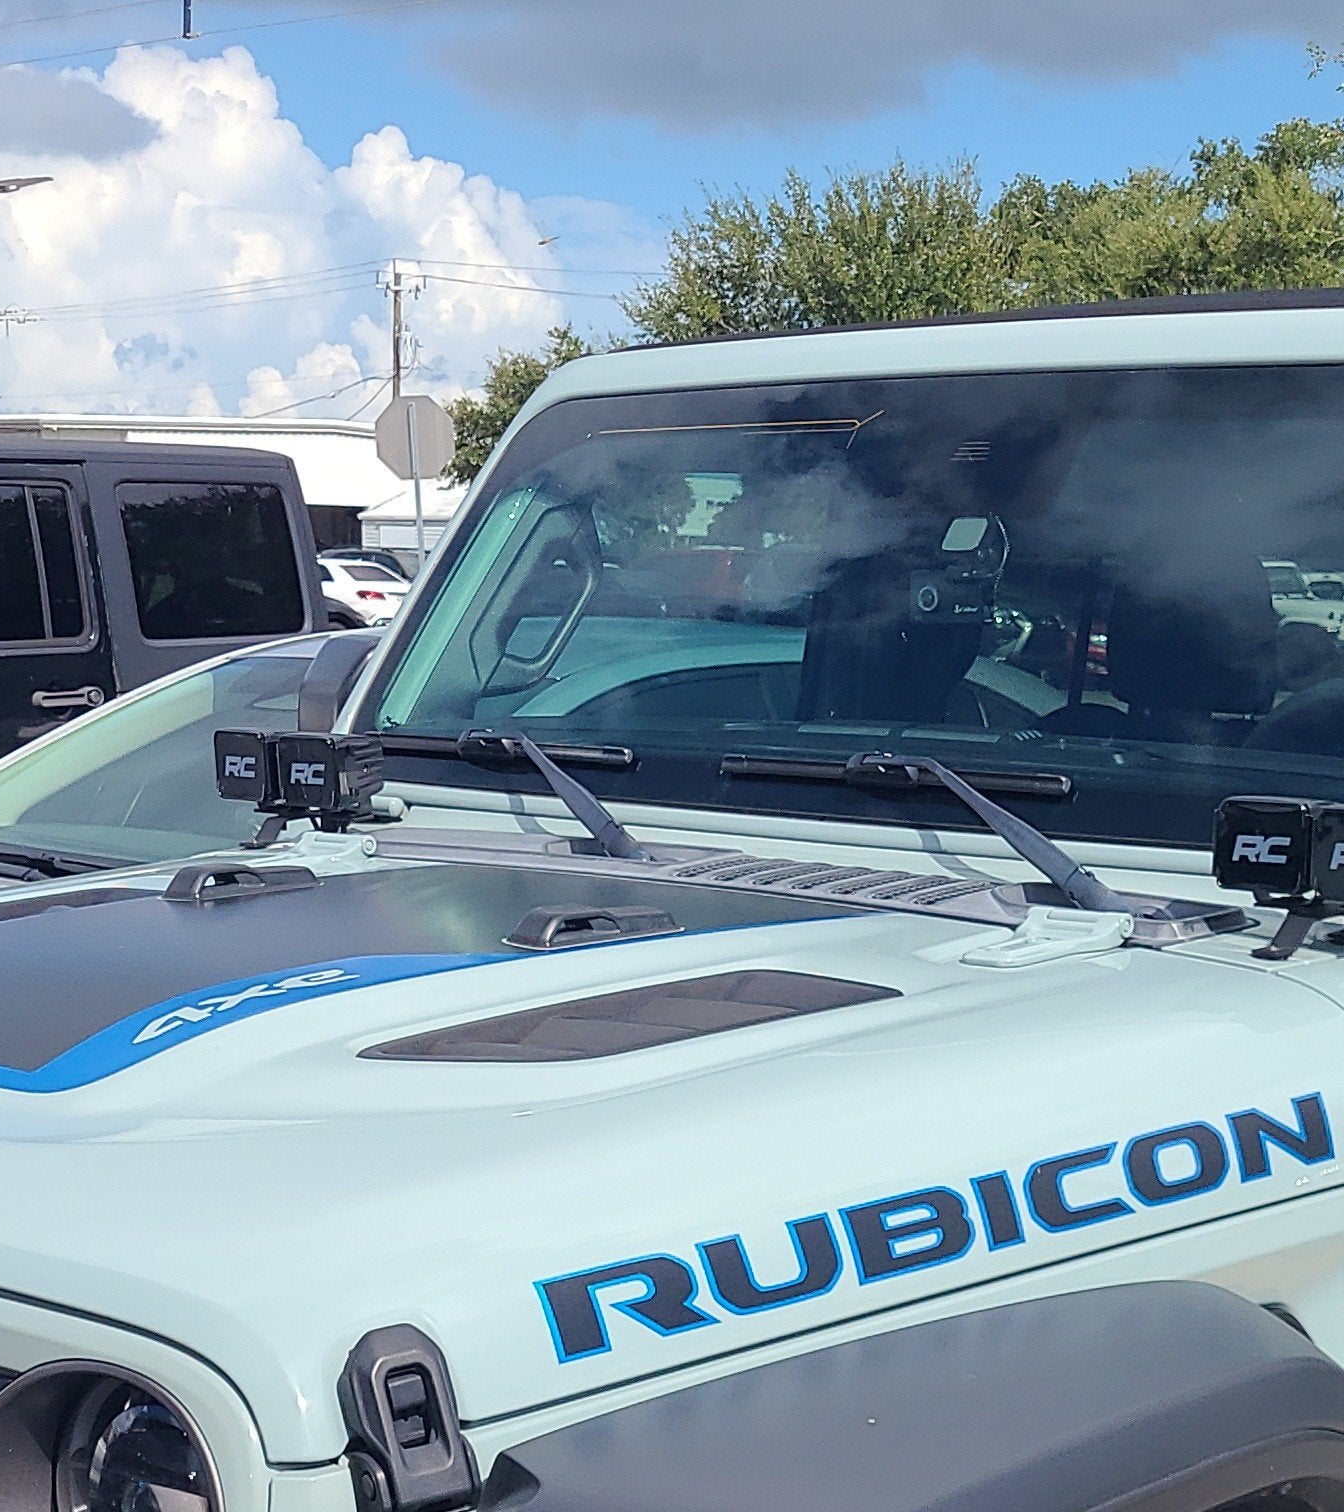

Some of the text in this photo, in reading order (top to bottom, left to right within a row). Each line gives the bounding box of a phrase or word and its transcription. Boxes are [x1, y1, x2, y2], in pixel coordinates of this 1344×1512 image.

[223, 755, 256, 778] RC
[289, 762, 327, 786] RC
[1231, 834, 1292, 864] RC
[532, 1090, 1337, 1365] RUBICON
